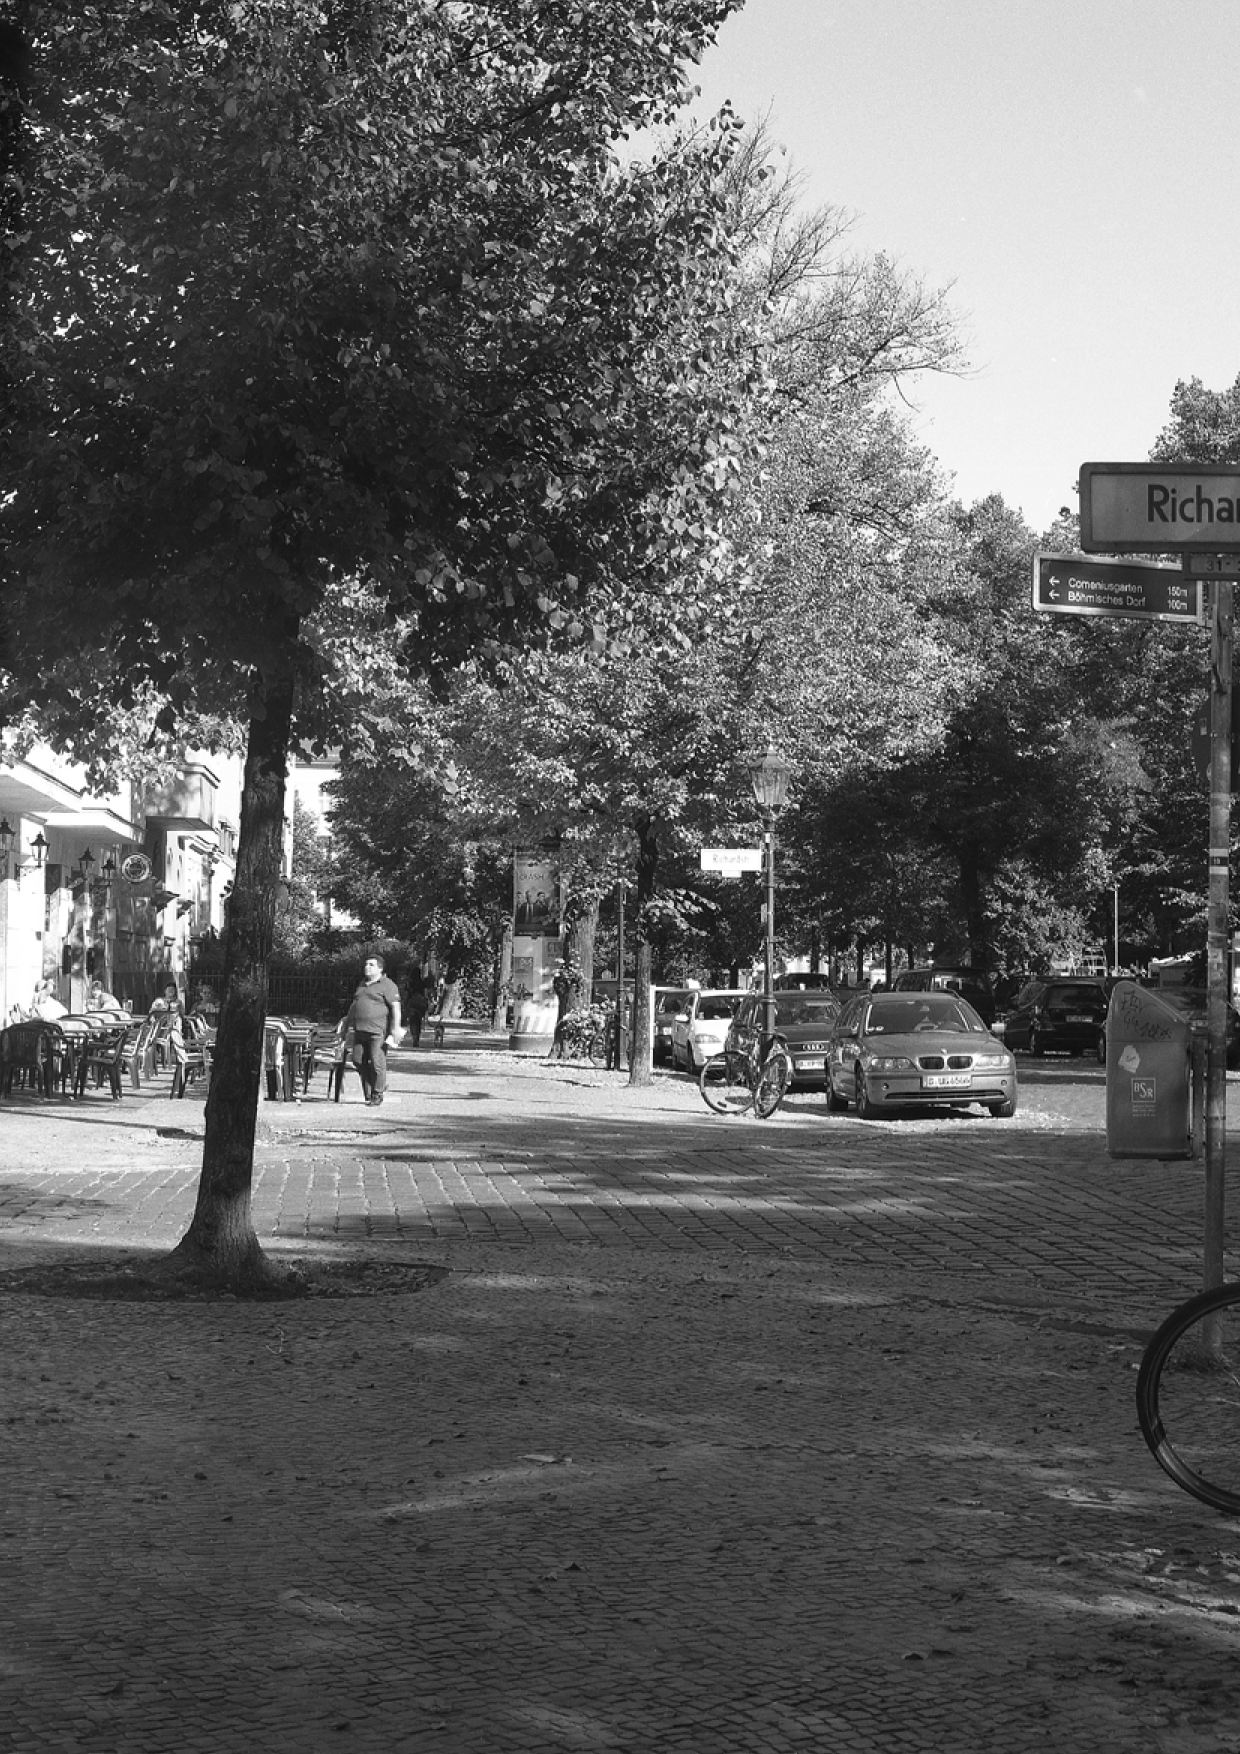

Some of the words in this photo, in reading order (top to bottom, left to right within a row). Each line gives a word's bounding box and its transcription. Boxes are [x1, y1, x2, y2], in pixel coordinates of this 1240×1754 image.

[1068, 577, 1143, 594] Comeniusgarten
[1068, 590, 1124, 606] Böhmisches
[1126, 595, 1146, 607] Dorf
[1133, 1082, 1154, 1099] BSR
